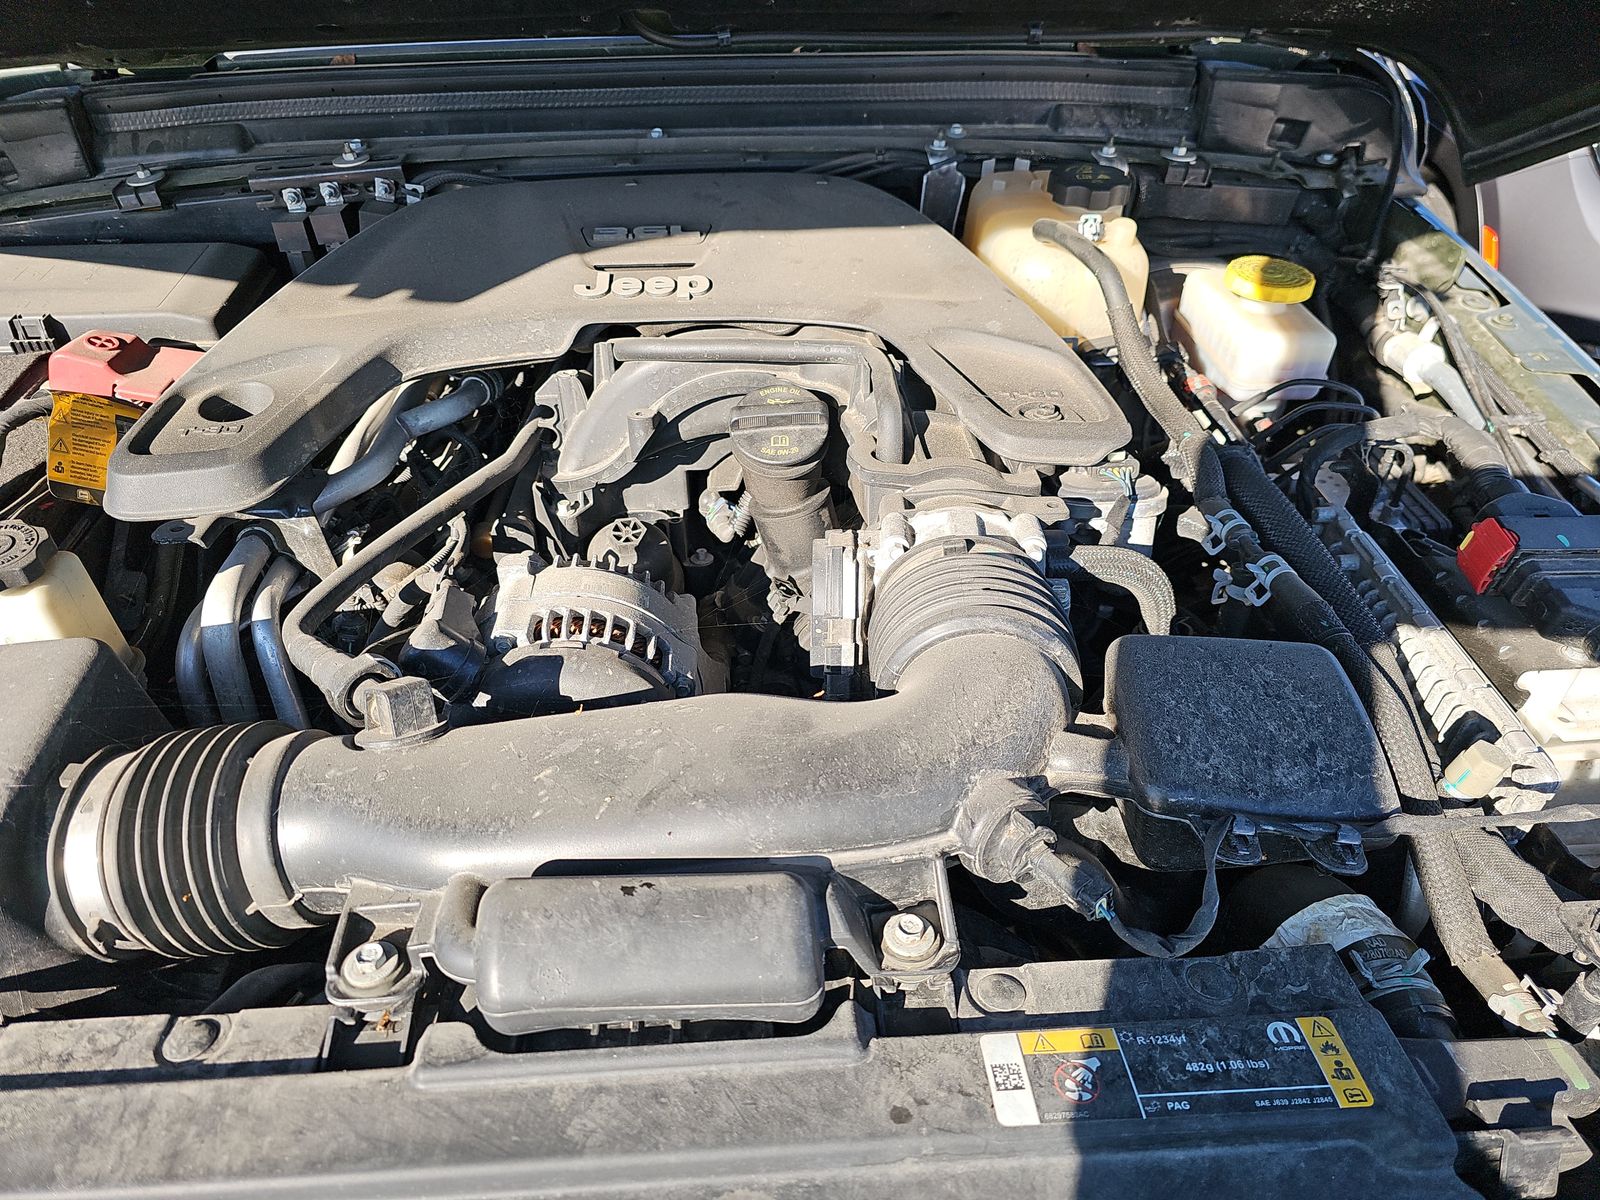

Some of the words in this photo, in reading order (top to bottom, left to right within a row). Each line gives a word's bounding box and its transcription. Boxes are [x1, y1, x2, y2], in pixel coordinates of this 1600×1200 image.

[573, 270, 713, 302] Jeep
[760, 386, 788, 396] ENGINE
[789, 387, 801, 396] OIL
[761, 446, 777, 455] SAE
[777, 447, 799, 456] 0W-20
[1364, 937, 1387, 949] RAD
[1136, 1034, 1188, 1047] R-1234yf
[1185, 1061, 1214, 1073] 482g
[1216, 1060, 1244, 1072] (1.06
[1246, 1058, 1270, 1070] lbs)
[1166, 1101, 1191, 1111] PAG
[1254, 1099, 1271, 1107] SAE
